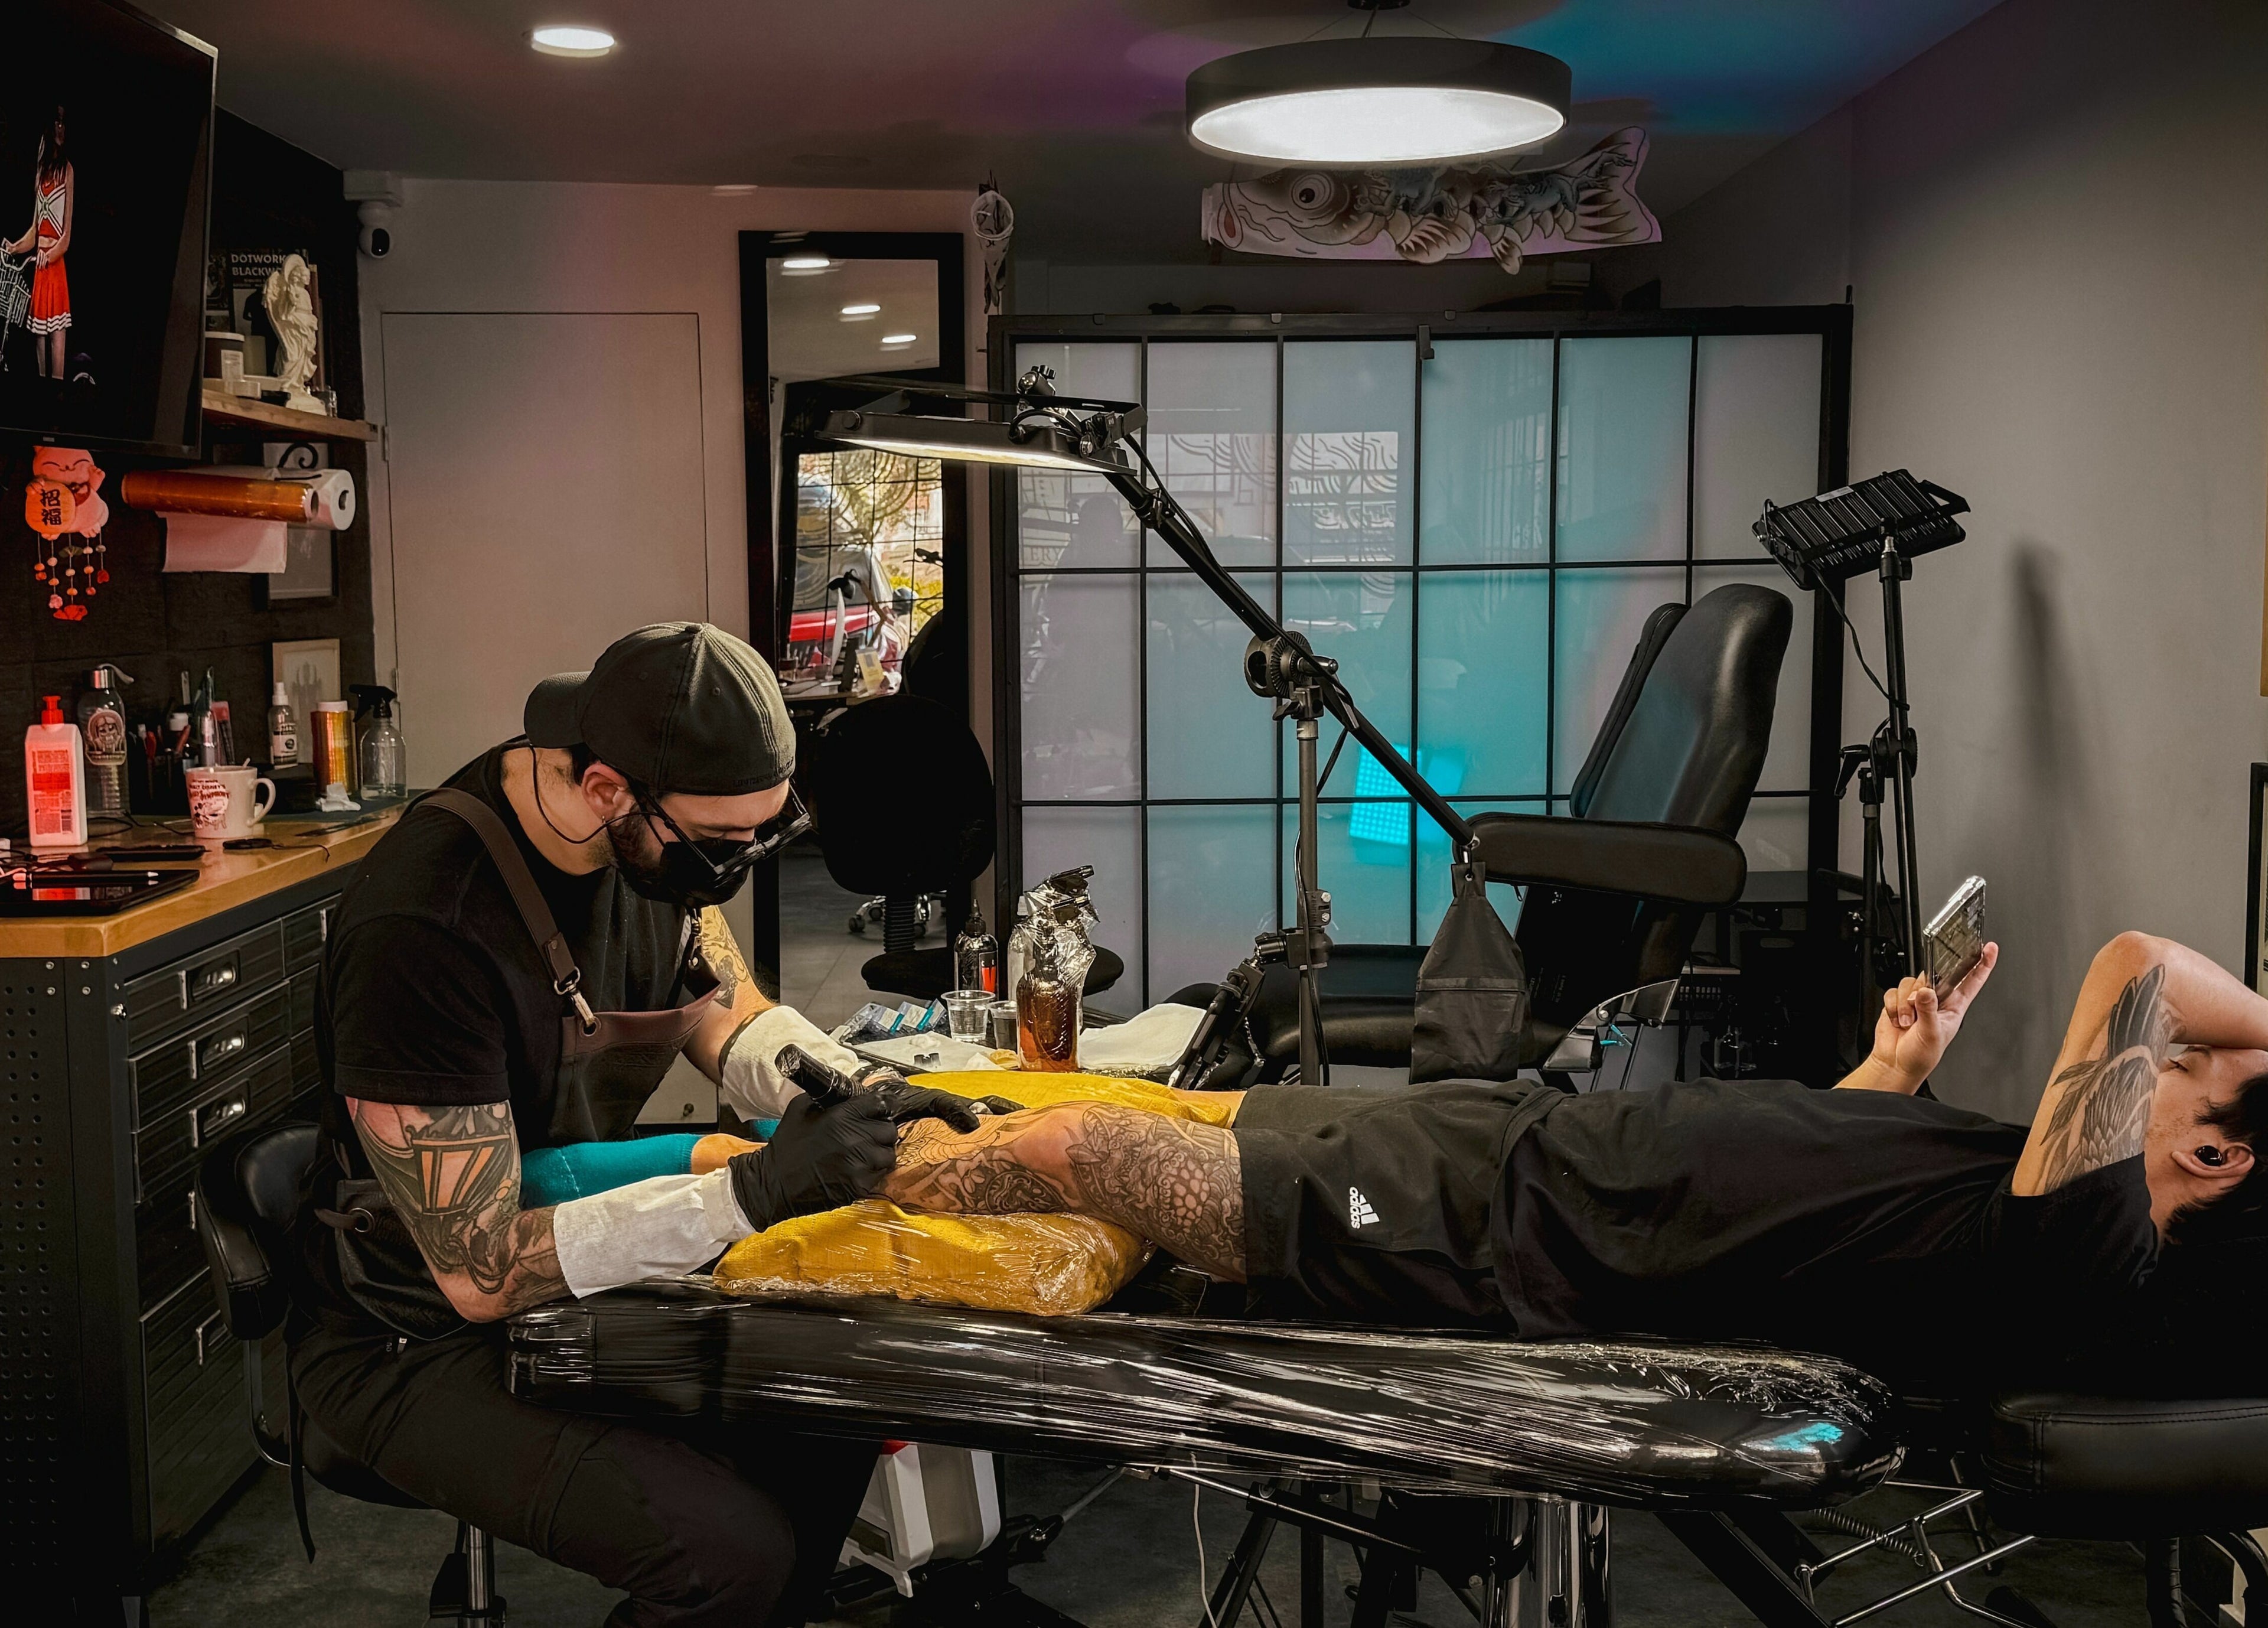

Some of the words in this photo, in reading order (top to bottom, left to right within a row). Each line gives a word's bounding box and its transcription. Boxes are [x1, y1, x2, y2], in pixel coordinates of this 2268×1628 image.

[231, 254, 286, 263] DOTWORK
[232, 266, 282, 276] BLACKW
[40, 489, 61, 525] 招福
[1350, 1187, 1361, 1229] adidas
